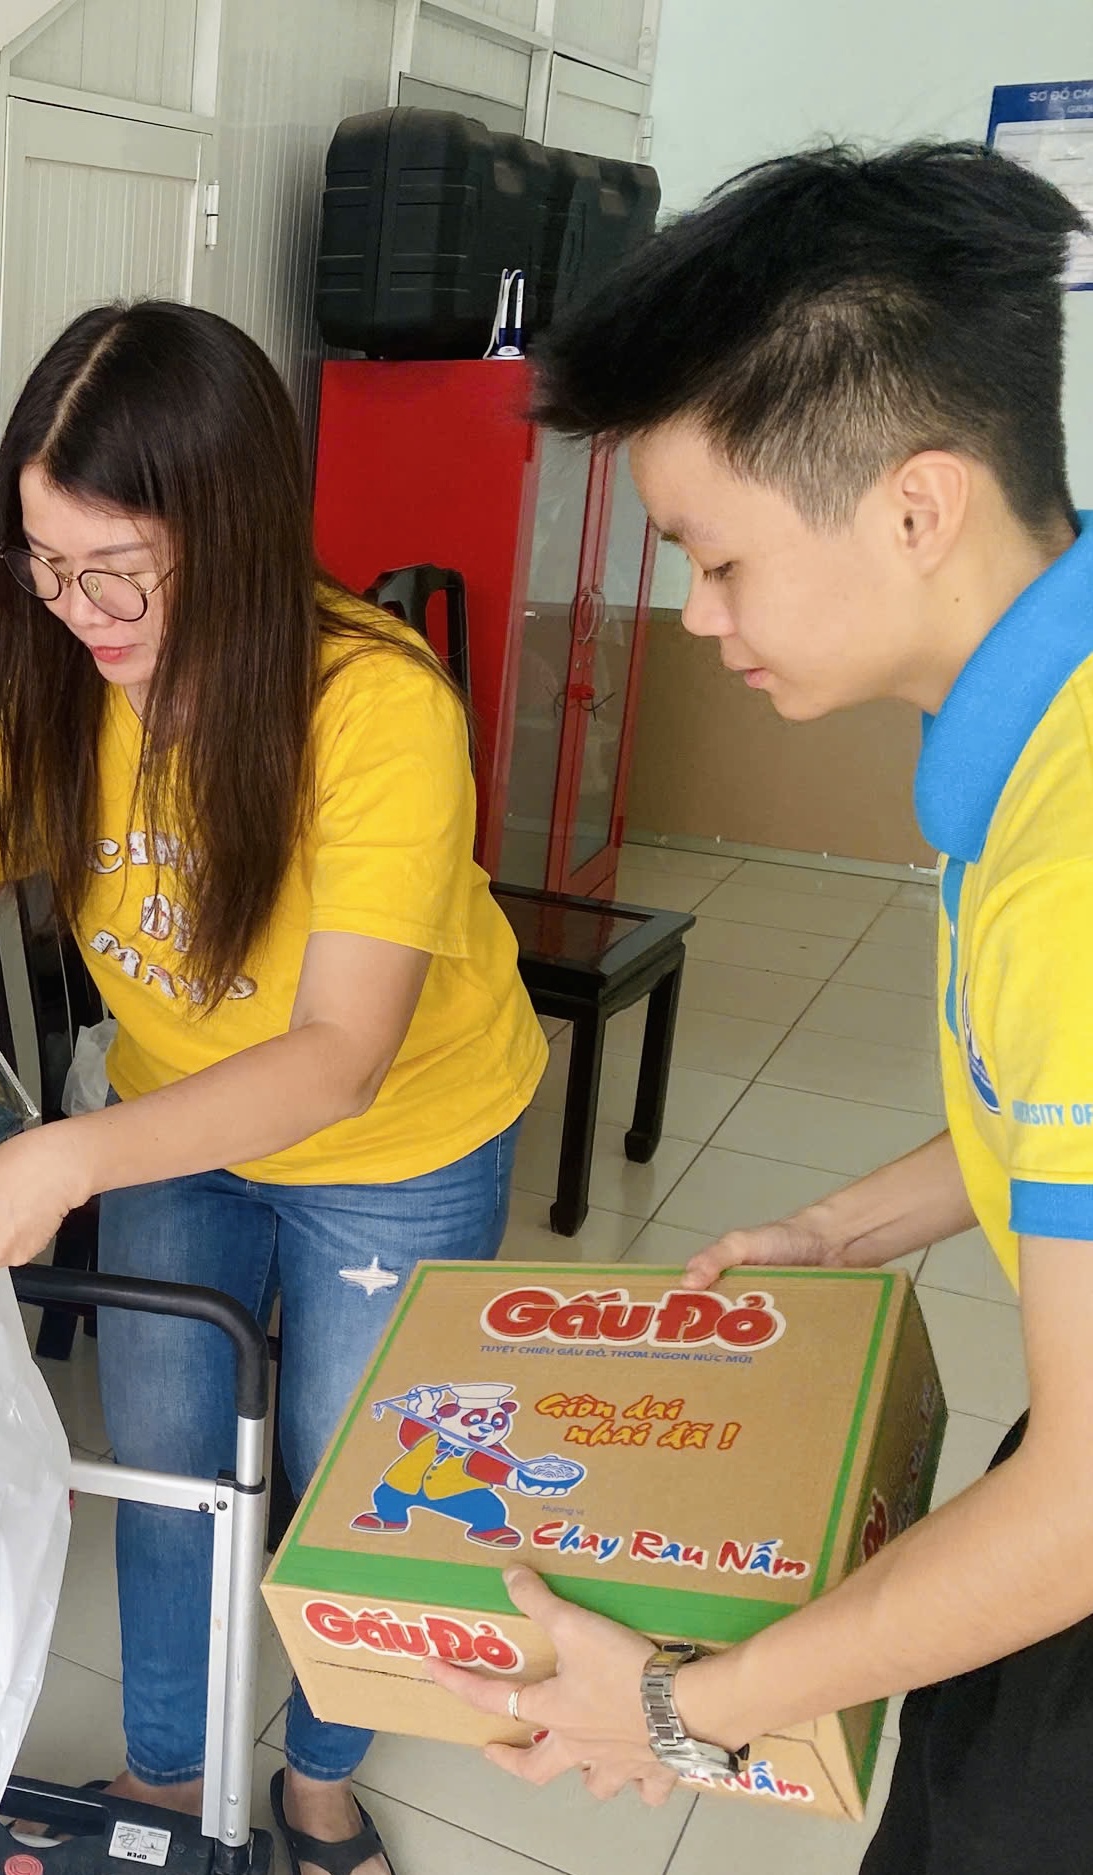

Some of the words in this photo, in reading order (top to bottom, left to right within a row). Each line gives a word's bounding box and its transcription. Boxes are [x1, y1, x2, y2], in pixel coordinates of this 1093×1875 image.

[651, 1351, 690, 1361] NGON
[622, 1394, 686, 1421] dai
[564, 1419, 653, 1448] nhai
[656, 1420, 714, 1450] đã
[532, 1521, 621, 1561] Chay
[630, 1530, 707, 1568] Rau
[717, 1539, 809, 1578] Nấm
[126, 1851, 147, 1860] OPEN
